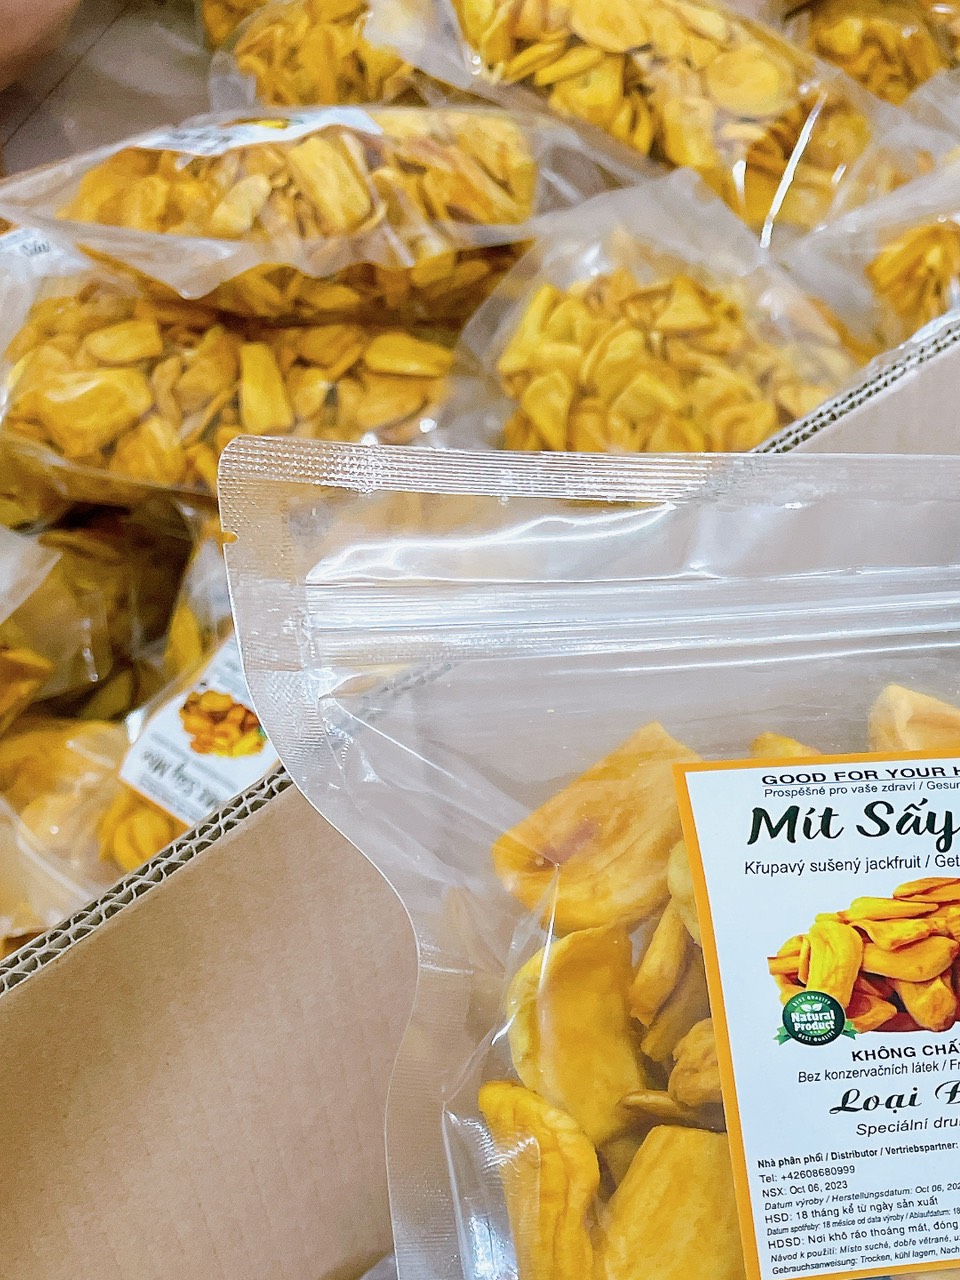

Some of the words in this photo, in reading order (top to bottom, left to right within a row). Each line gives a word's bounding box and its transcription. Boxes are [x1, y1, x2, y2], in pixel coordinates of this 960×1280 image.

[760, 772, 827, 785] GOOD
[833, 769, 879, 781] FOR
[884, 766, 946, 779] YOUR
[828, 786, 848, 797] pro
[850, 782, 878, 794] vaše
[880, 780, 916, 792] zdraví
[746, 804, 845, 845] Mít
[744, 858, 805, 877] Křupavý
[809, 856, 861, 875] sušený
[864, 854, 922, 874] jackfruit
[791, 1010, 835, 1022] Natural
[794, 1020, 835, 1031] Product
[850, 1044, 917, 1062] KHÔNG
[797, 1070, 821, 1083] Bez
[823, 1062, 908, 1081] konzervačních
[911, 1059, 940, 1074] látek
[828, 1086, 922, 1115] Loại
[855, 1117, 929, 1138] Speciální
[756, 1157, 776, 1169] Nhà
[777, 1155, 802, 1168] phân
[829, 1148, 878, 1161] Distributor
[884, 1141, 959, 1155] Vertriebspartner:
[757, 1172, 778, 1183] Tel:
[788, 1184, 806, 1195] Oct
[806, 1182, 823, 1193] 06,
[823, 1179, 848, 1191] 2023
[763, 1211, 793, 1224] HSD:
[795, 1209, 809, 1220] 18
[810, 1207, 840, 1219] tháng
[856, 1202, 867, 1213] từ
[868, 1200, 894, 1213] ngày
[895, 1197, 915, 1209] sản
[916, 1194, 939, 1207] xuất
[766, 1235, 805, 1250] HDSD:
[806, 1233, 826, 1244] Nơi
[827, 1230, 848, 1242] khô
[849, 1228, 868, 1239] ráo
[869, 1225, 905, 1237] thoáng
[907, 1222, 931, 1233] mát,
[932, 1219, 959, 1231] đóng
